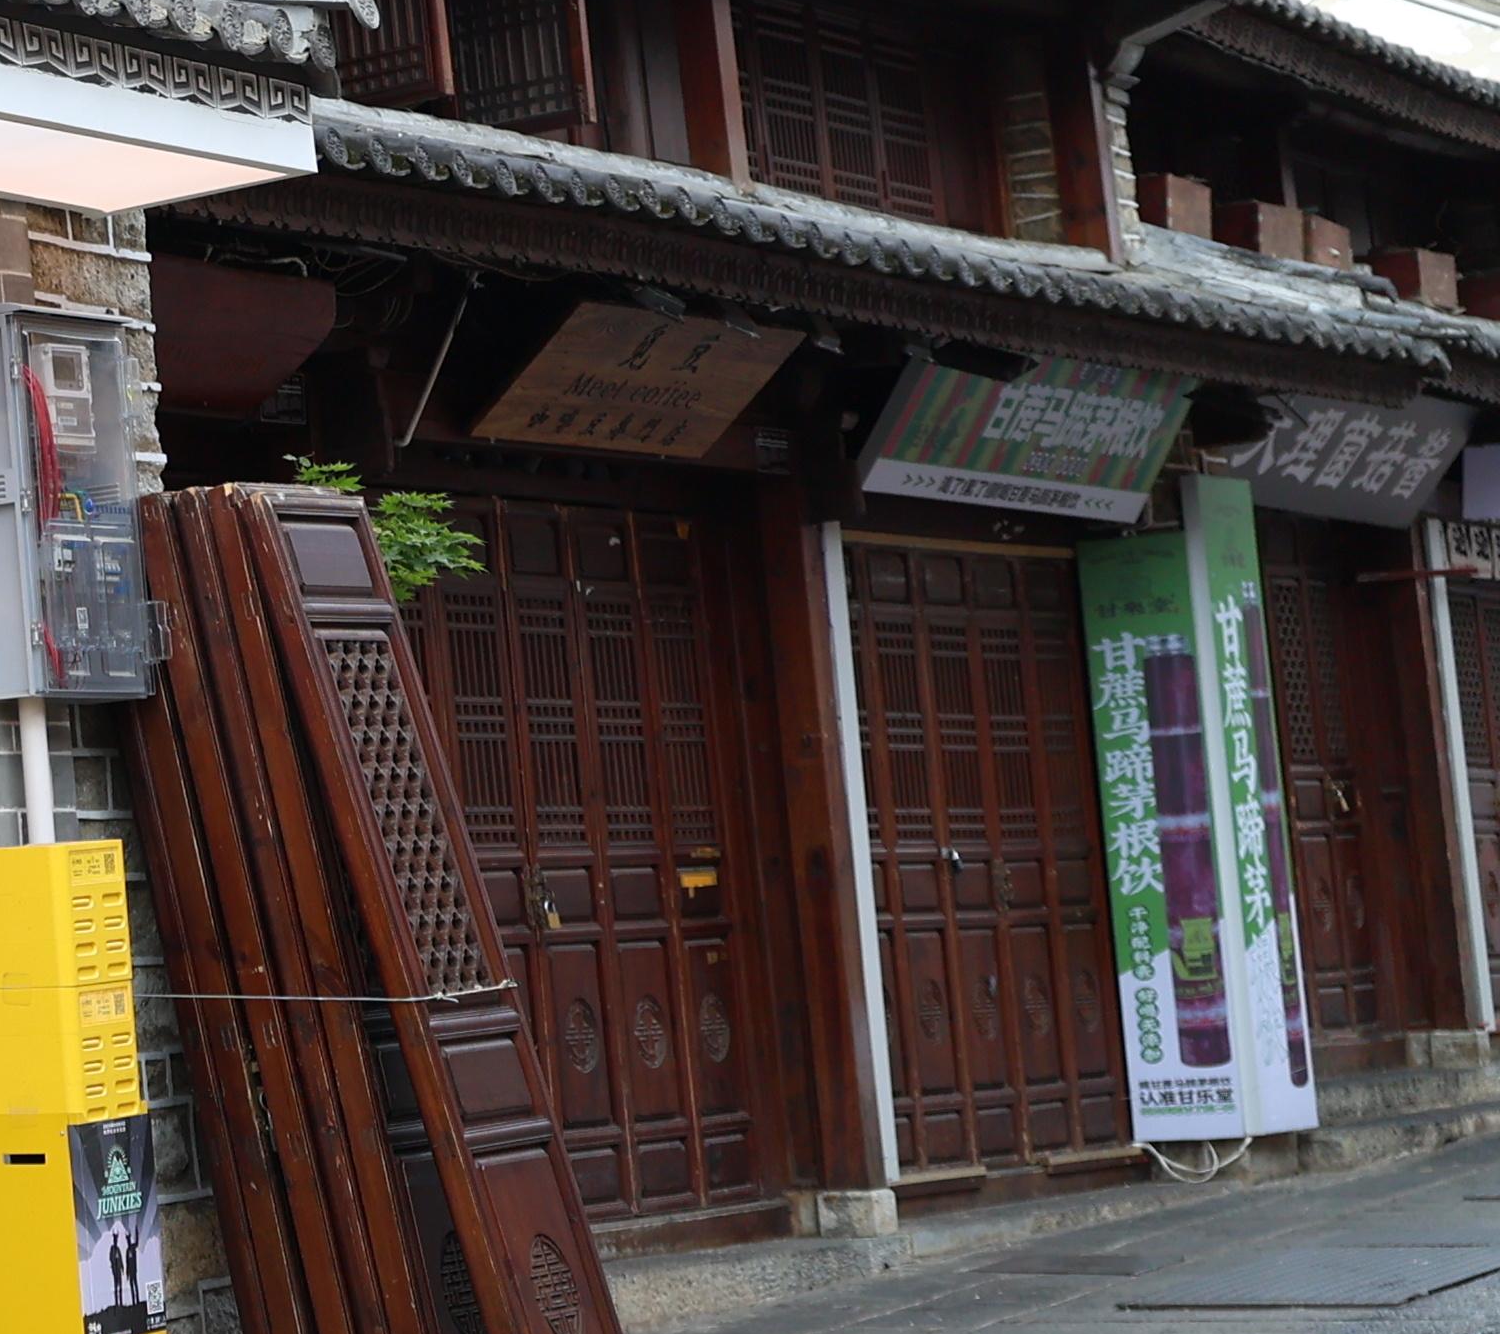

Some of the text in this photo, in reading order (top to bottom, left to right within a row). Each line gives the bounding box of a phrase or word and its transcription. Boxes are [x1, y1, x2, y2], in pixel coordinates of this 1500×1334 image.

[1092, 631, 1164, 896] 甘蔗马蹄茅根饮
[97, 1191, 142, 1219] JUNKIES
